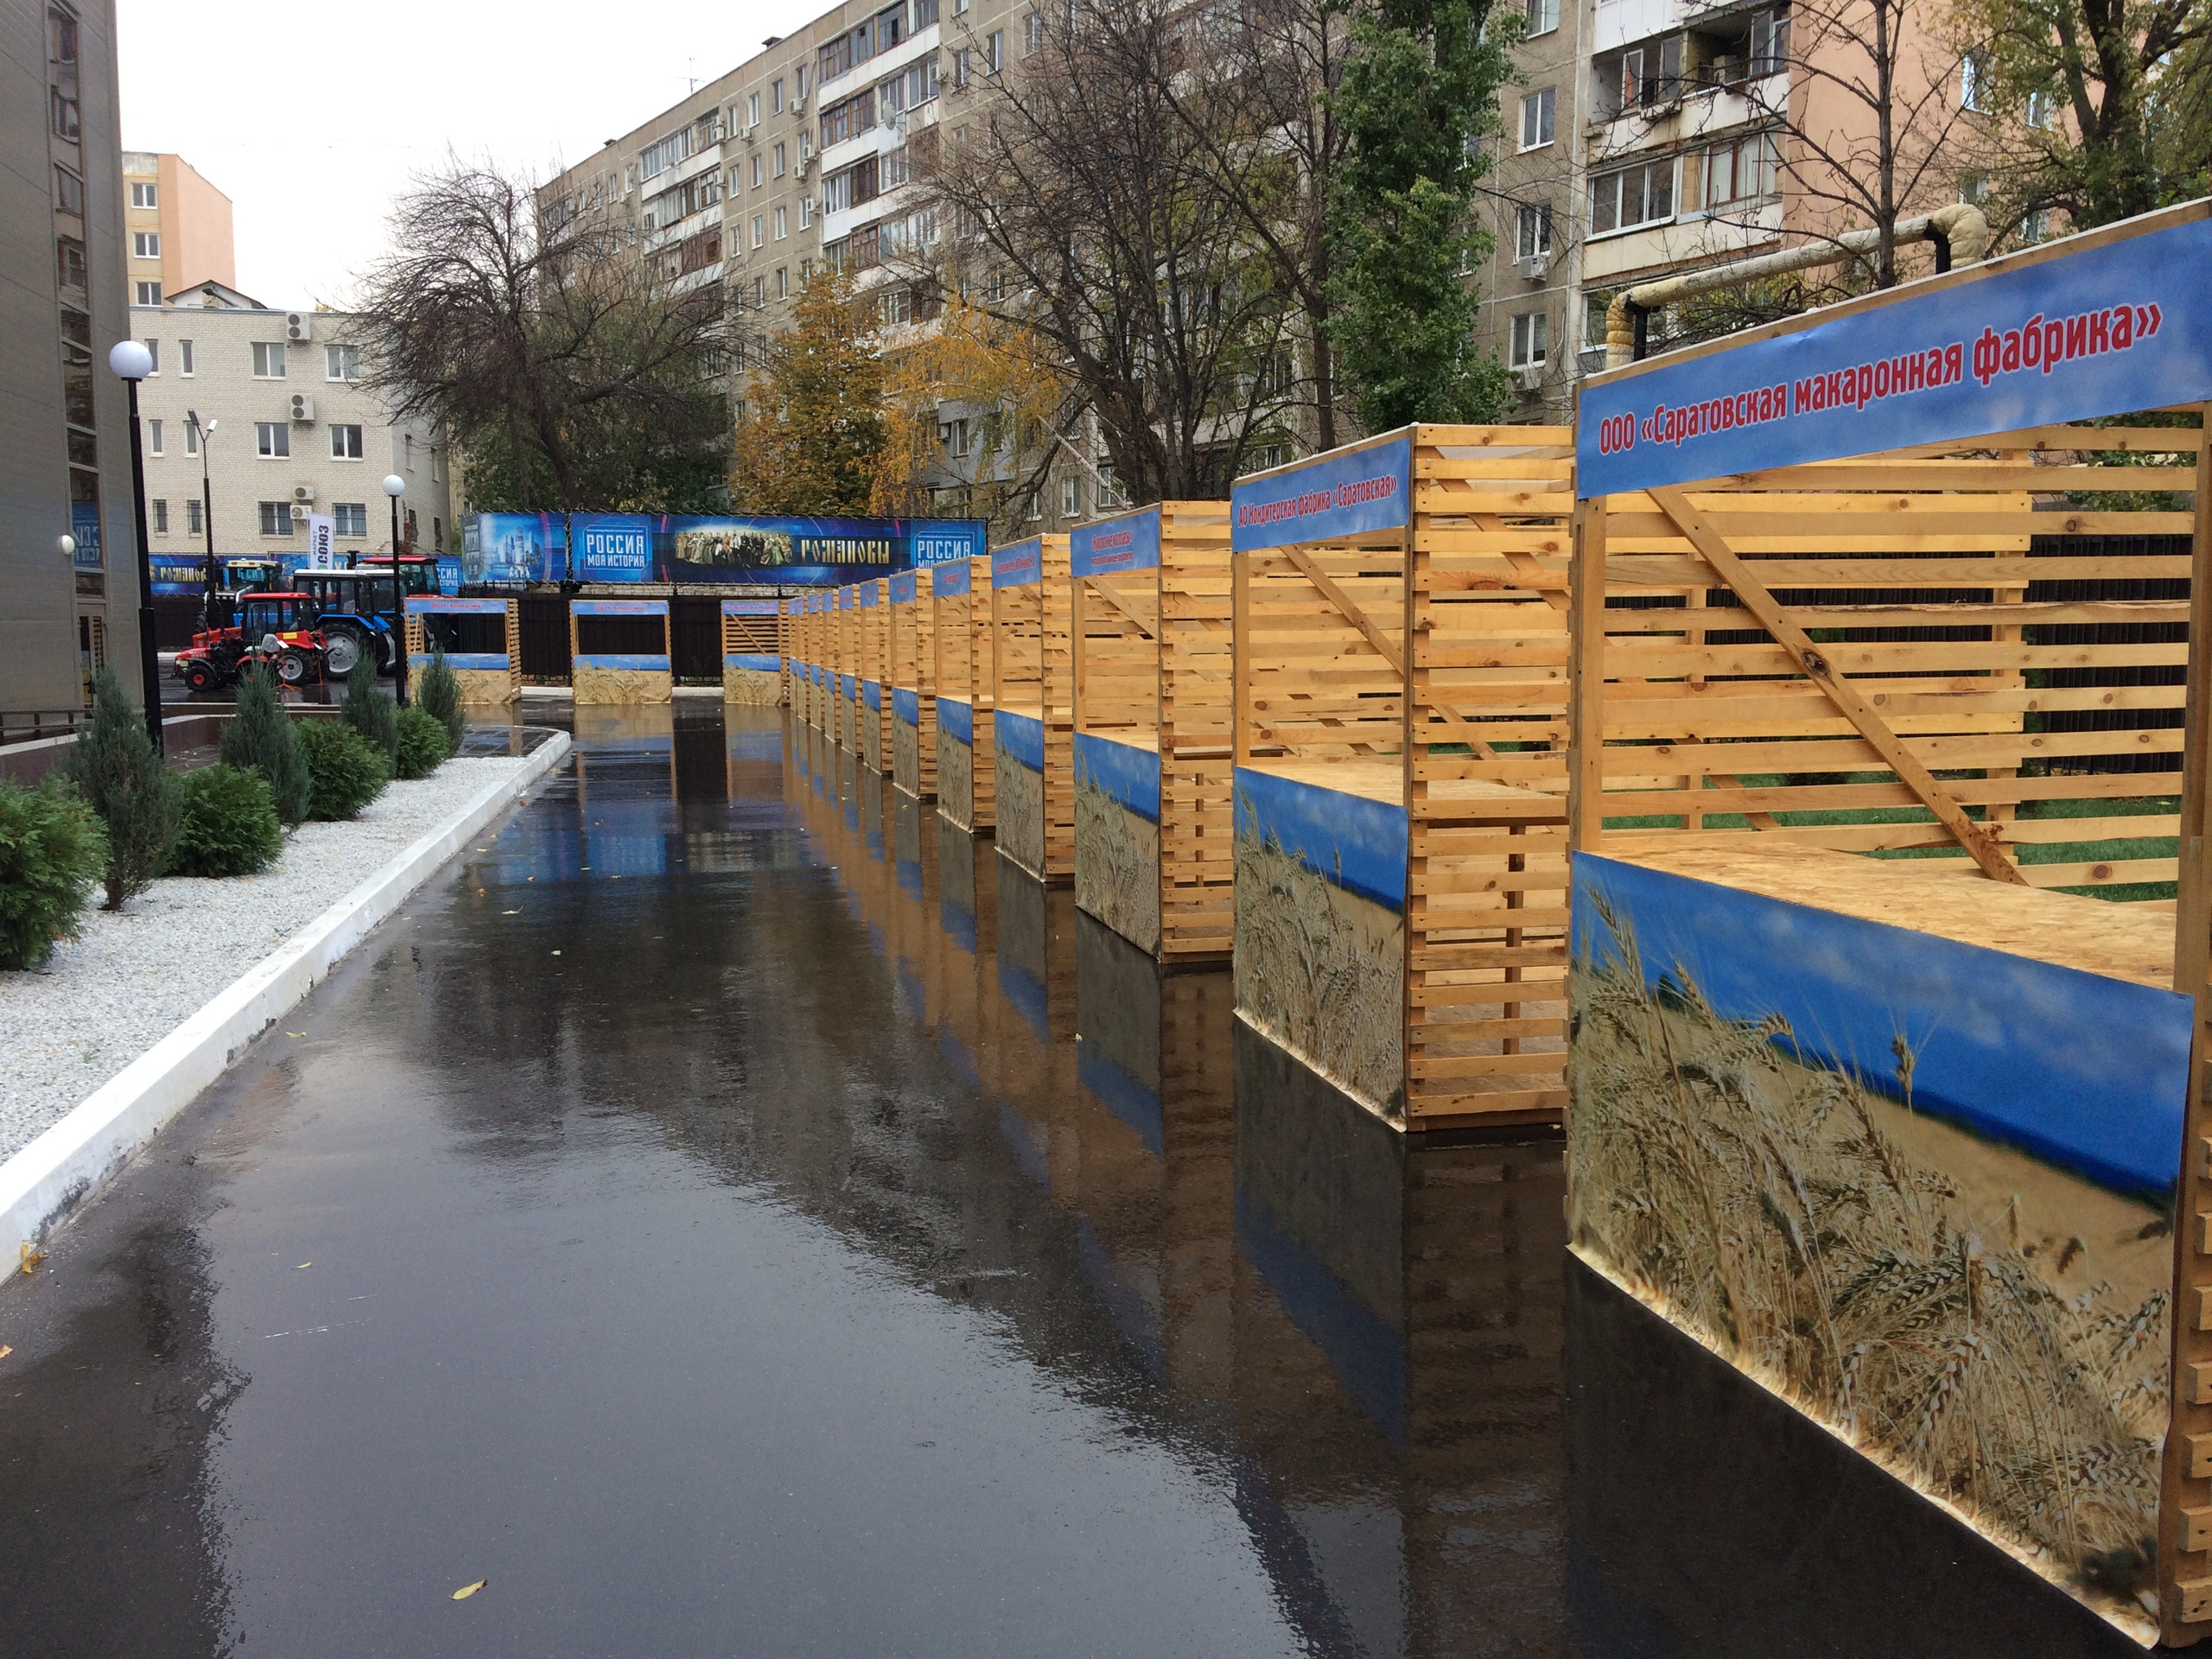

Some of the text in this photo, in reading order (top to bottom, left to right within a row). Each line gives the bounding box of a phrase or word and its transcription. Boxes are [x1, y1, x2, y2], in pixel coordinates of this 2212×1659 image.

[1599, 302, 2163, 455] ООО «Саратовская макаронная фабрика»
[1238, 474, 1397, 528] АО Кондитерская фабрика «Саратовская»
[587, 534, 645, 554] РОССИЯ
[800, 539, 890, 564] РОМАНОВЫ
[918, 540, 970, 559] РОССИЯ
[588, 554, 645, 567] МОЯ ИСТОРИЯ
[436, 567, 458, 579] ССИЯ
